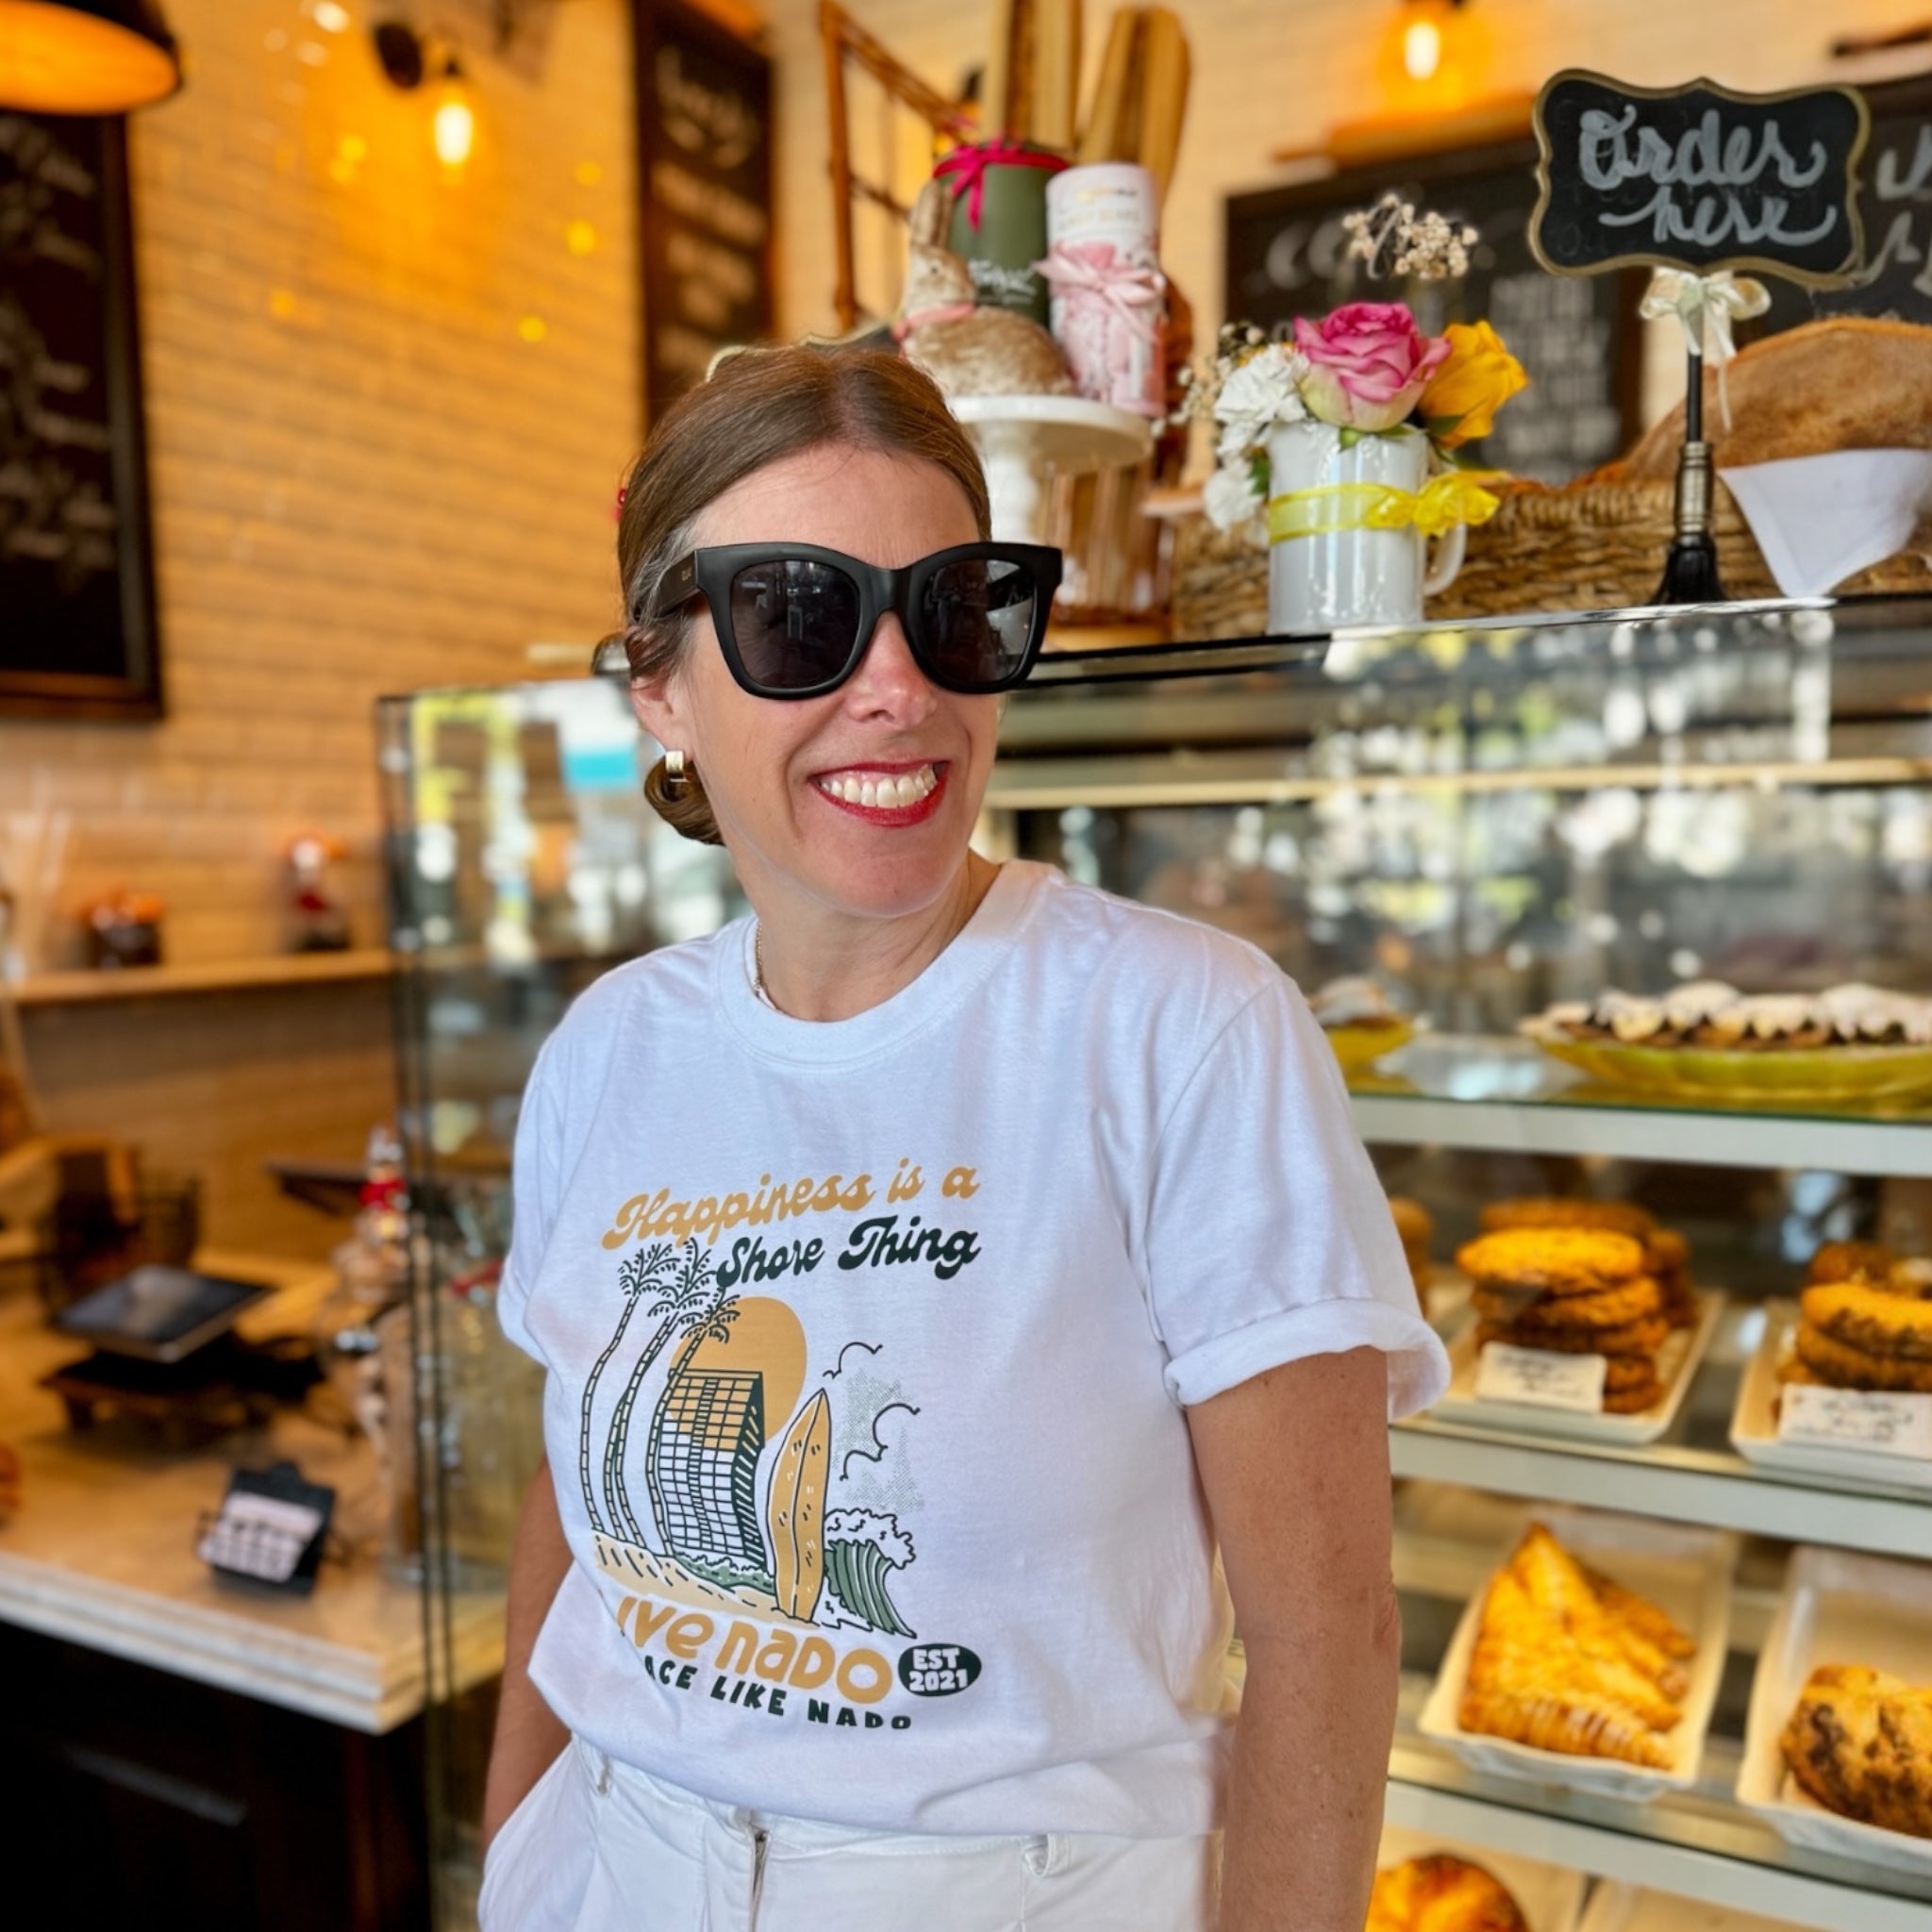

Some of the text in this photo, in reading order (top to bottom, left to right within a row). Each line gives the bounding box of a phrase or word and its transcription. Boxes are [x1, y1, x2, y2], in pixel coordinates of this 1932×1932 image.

[1579, 105, 1826, 189] Order
[1599, 185, 1837, 246] here
[602, 1158, 981, 1250] Happiness is a
[716, 1215, 982, 1287] Shore Thing
[644, 1655, 911, 1730] ACE LIKE NADO
[909, 1668, 968, 1692] 2021
[912, 1648, 960, 1670] EST
